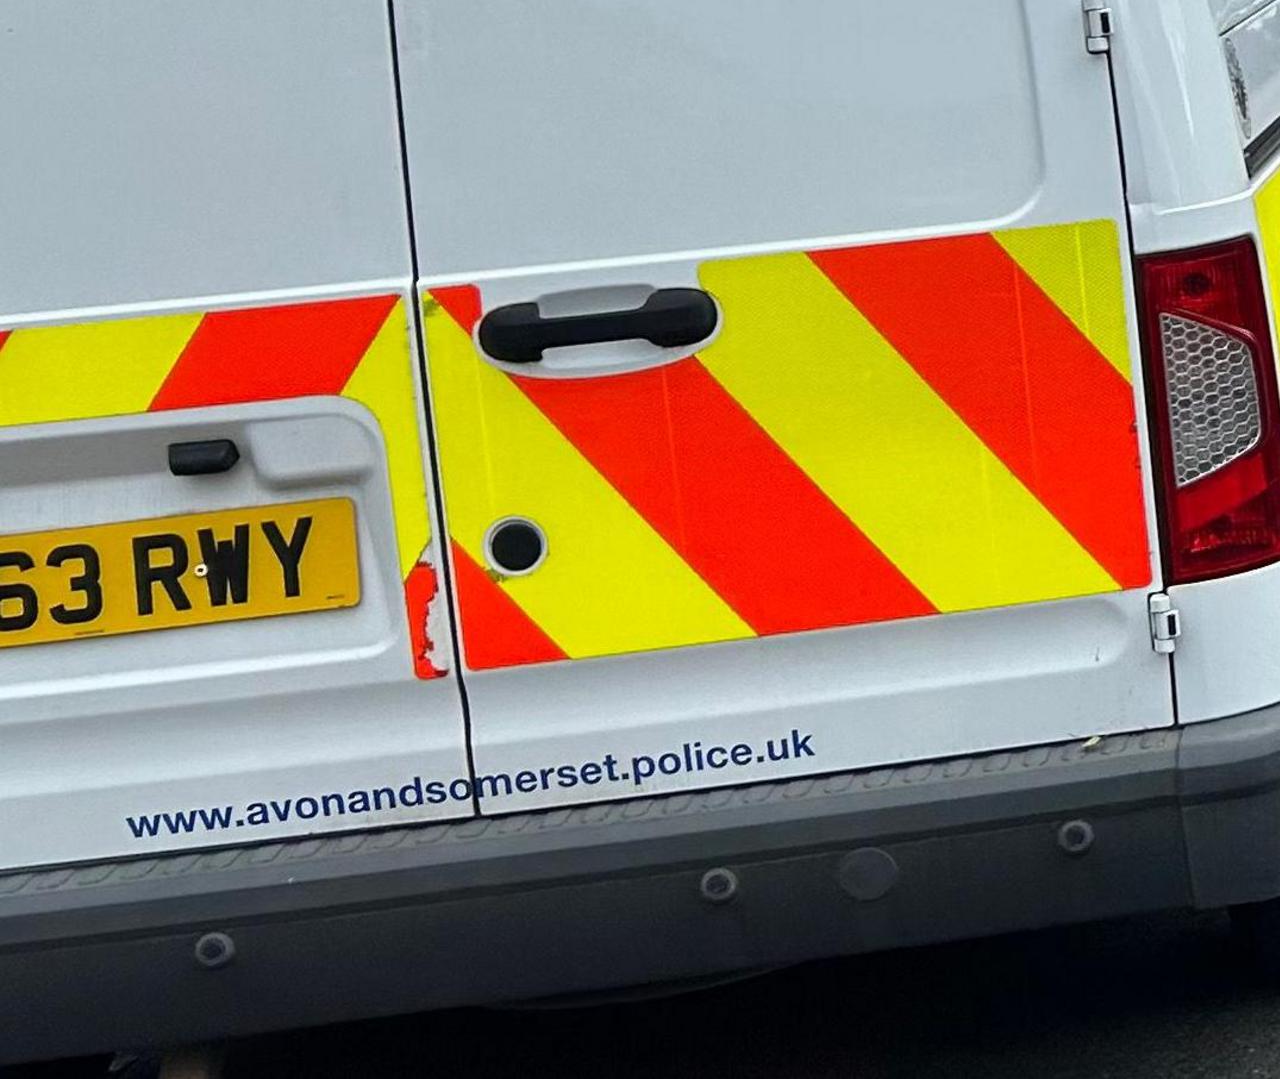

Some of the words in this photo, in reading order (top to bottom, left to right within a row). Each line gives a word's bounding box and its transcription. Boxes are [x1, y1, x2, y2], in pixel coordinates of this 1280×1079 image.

[0, 550, 103, 632] 63
[131, 516, 313, 616] RWY
[126, 729, 815, 839] www.avonandsomerset.police.uk
